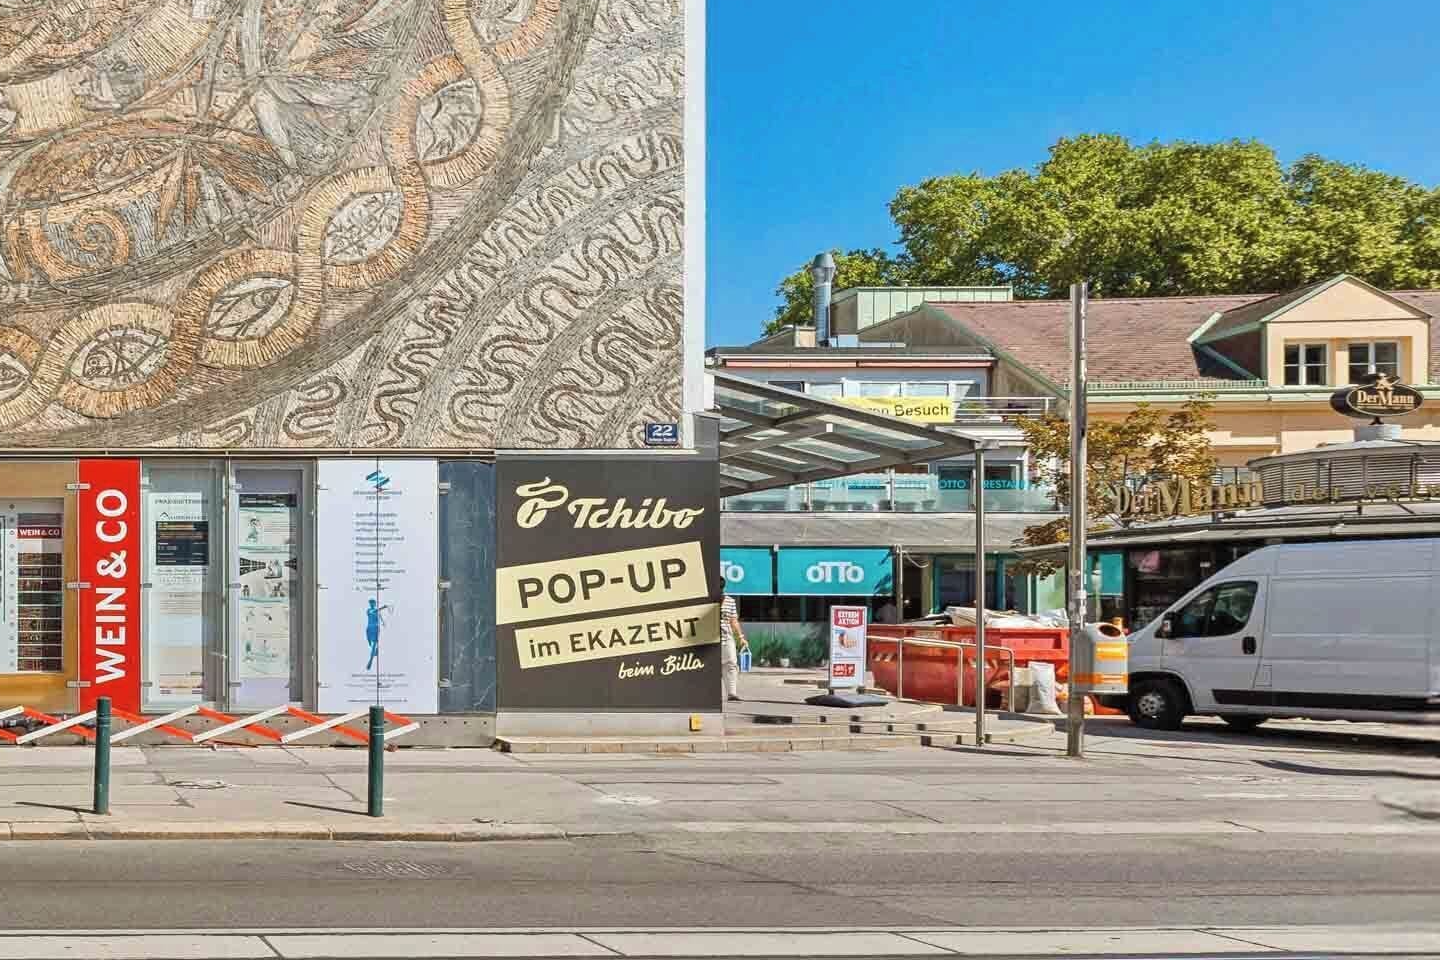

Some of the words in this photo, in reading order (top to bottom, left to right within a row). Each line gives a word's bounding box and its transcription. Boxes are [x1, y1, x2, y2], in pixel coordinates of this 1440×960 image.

[894, 402, 950, 417] Besuch
[652, 424, 673, 437] 22
[95, 489, 128, 543] CO
[567, 497, 705, 529] Tchibo
[96, 550, 127, 579] &
[806, 561, 865, 583] OTTO
[517, 558, 687, 609] POP-UP
[95, 587, 127, 684] WEIN
[529, 639, 561, 659] im
[568, 617, 700, 653] EKAZENT
[618, 662, 655, 679] beim
[660, 653, 705, 675] Billa
